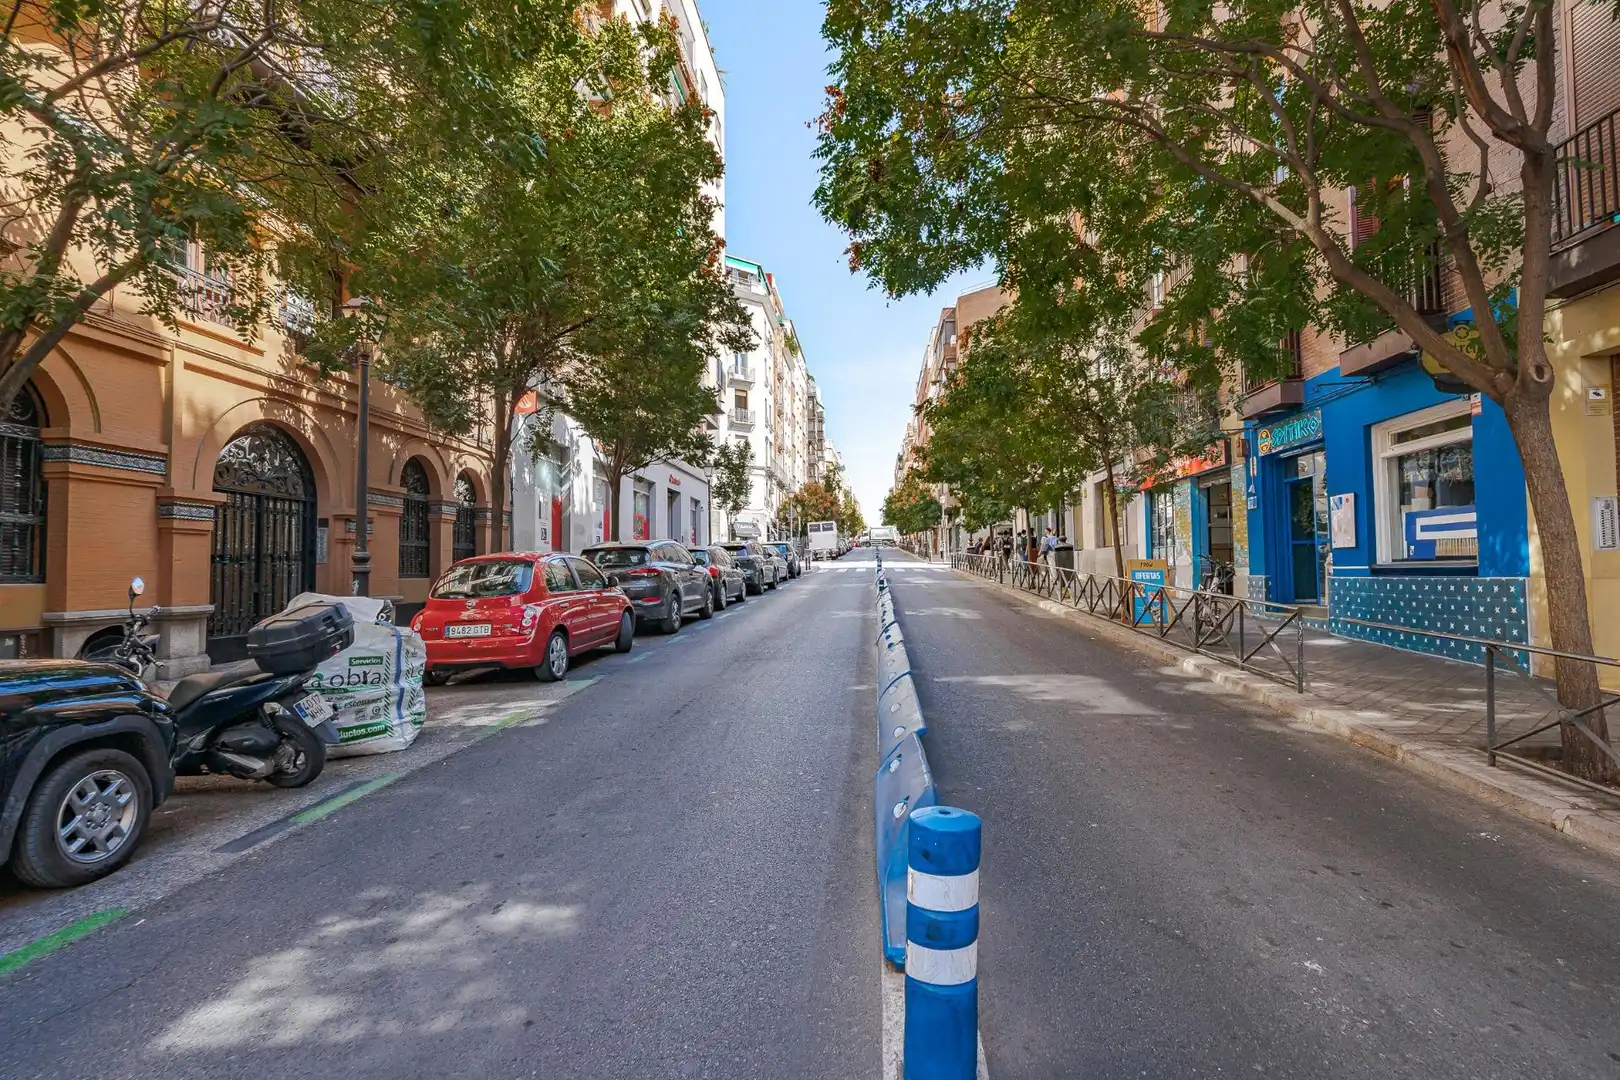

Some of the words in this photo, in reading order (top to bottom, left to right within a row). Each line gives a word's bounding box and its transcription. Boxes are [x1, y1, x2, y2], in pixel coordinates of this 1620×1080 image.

[1135, 571, 1161, 580] OFERTAS
[350, 657, 382, 666] Servicios
[330, 668, 381, 687] obra
[339, 723, 386, 739] uctos.com
